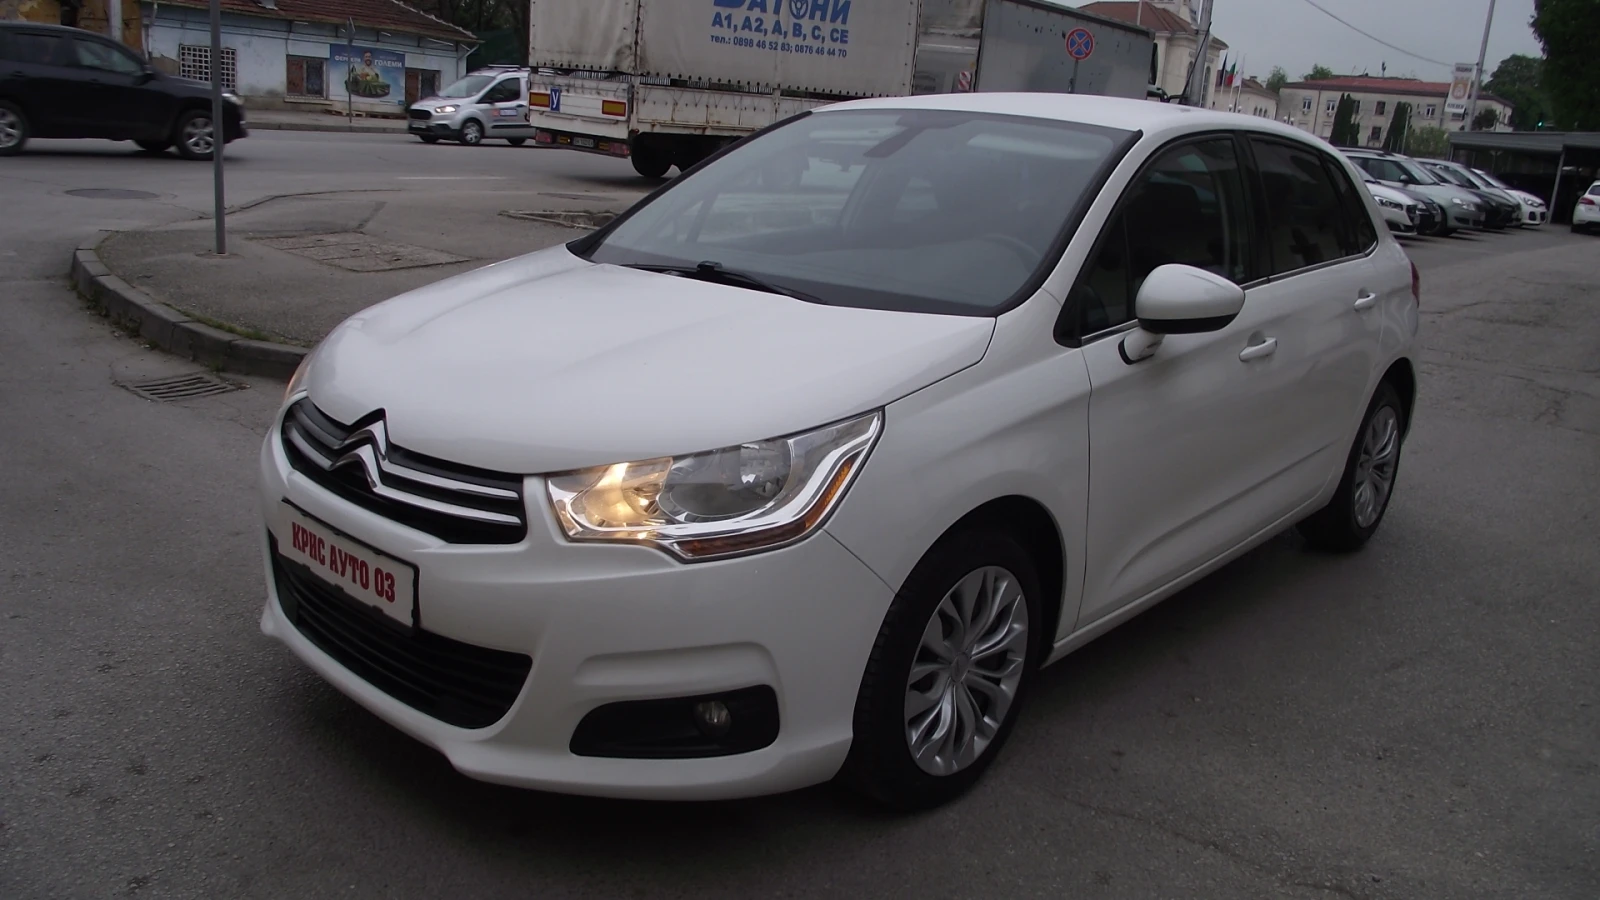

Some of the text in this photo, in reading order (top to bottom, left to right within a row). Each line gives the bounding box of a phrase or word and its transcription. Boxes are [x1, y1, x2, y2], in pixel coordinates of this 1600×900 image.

[733, 36, 754, 48] 0898
[756, 40, 767, 50] 46
[768, 41, 779, 51] 52
[794, 44, 814, 55] 0876
[815, 47, 825, 56] 46
[827, 48, 836, 57] 44
[838, 49, 847, 58] 70
[329, 544, 370, 590] АУТО
[374, 567, 396, 603] 03
